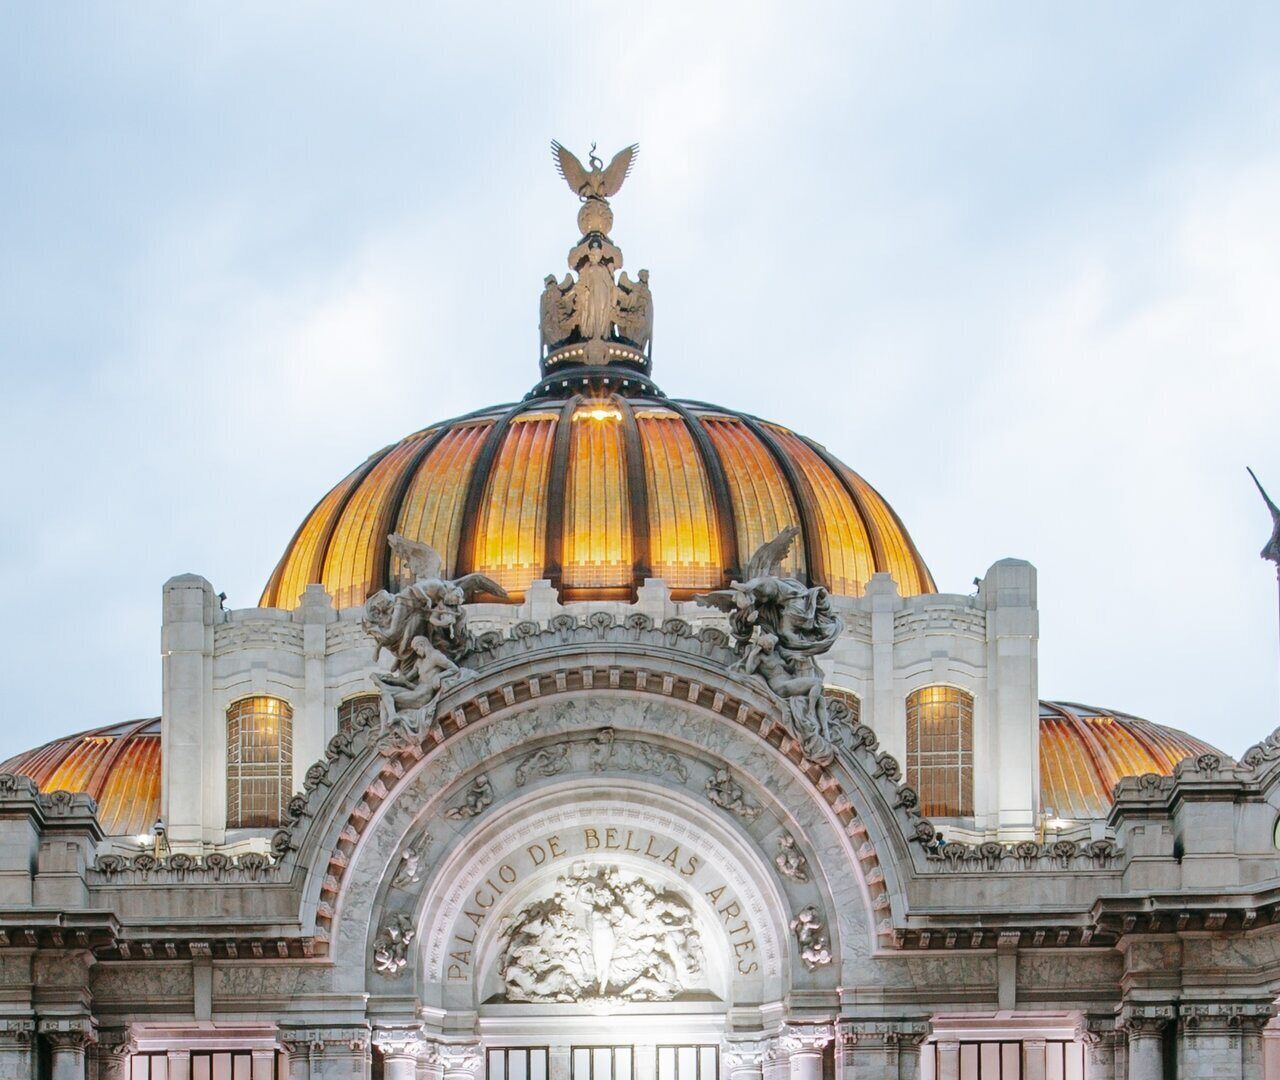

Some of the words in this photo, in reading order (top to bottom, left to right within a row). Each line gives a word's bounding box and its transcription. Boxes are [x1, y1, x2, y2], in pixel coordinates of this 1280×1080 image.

[447, 864, 517, 981] PALACIO
[527, 835, 567, 866] DE
[583, 827, 700, 877] BELLAS
[705, 885, 759, 975] ARTES
